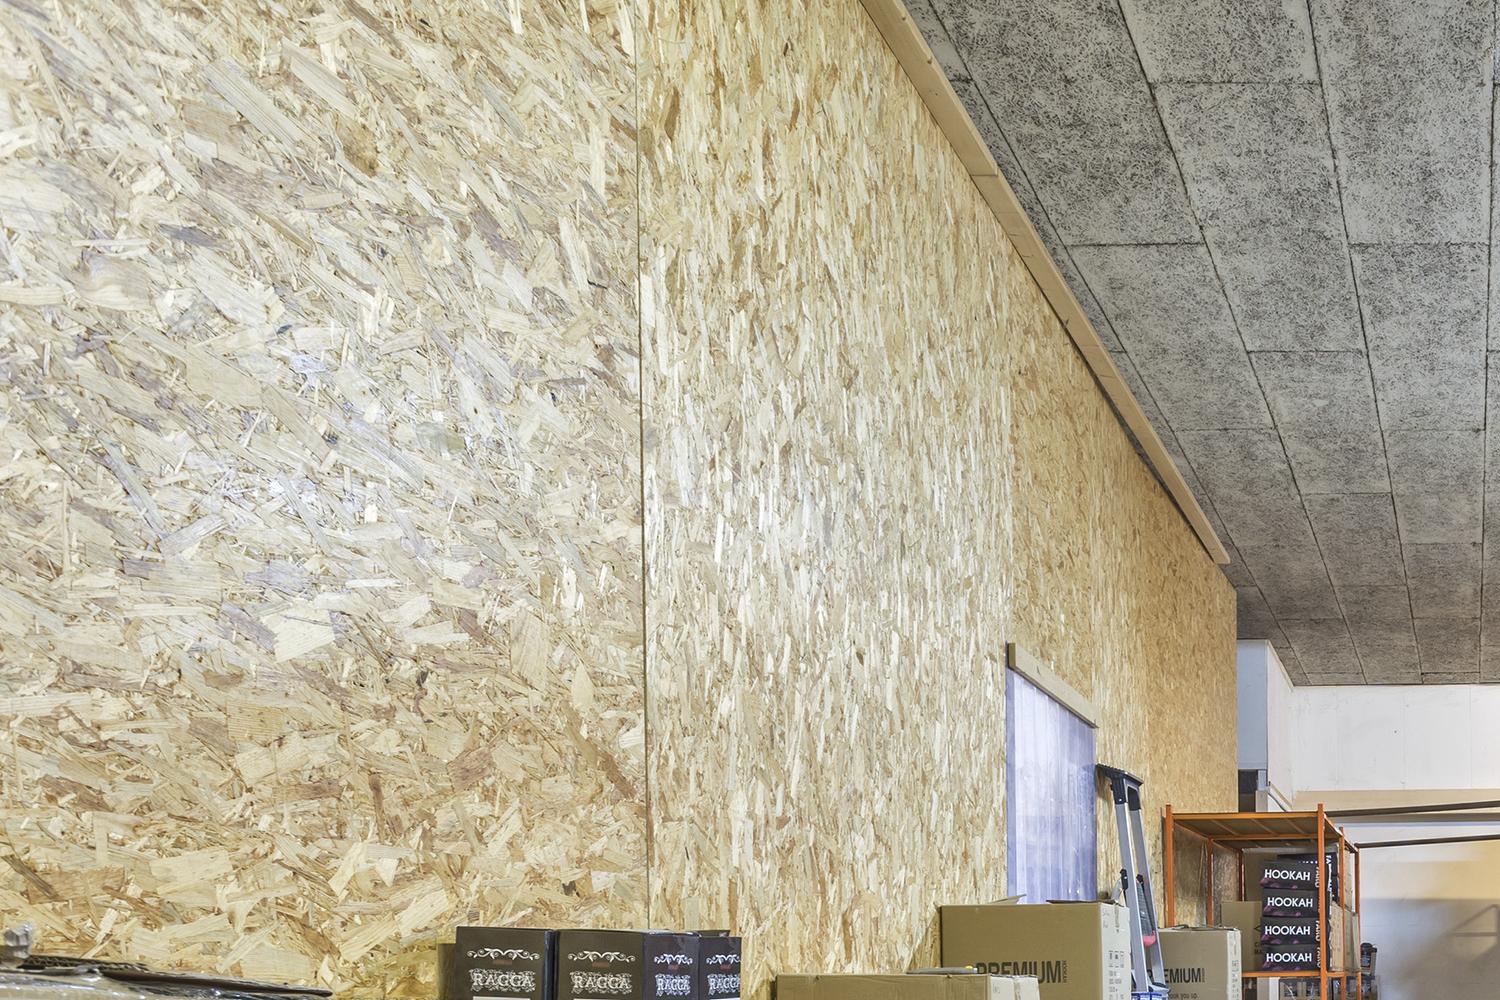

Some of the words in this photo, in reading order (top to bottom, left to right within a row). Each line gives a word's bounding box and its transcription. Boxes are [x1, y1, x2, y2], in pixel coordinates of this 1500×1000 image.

[1264, 869, 1311, 881] HOOKAH
[1267, 897, 1313, 907] HOOKAH
[1264, 926, 1311, 935] HOOKAH
[1266, 953, 1312, 962] HOOKAH
[471, 970, 535, 992] RAGGA
[571, 972, 632, 992] RAGGA
[656, 975, 690, 993] RAGGA
